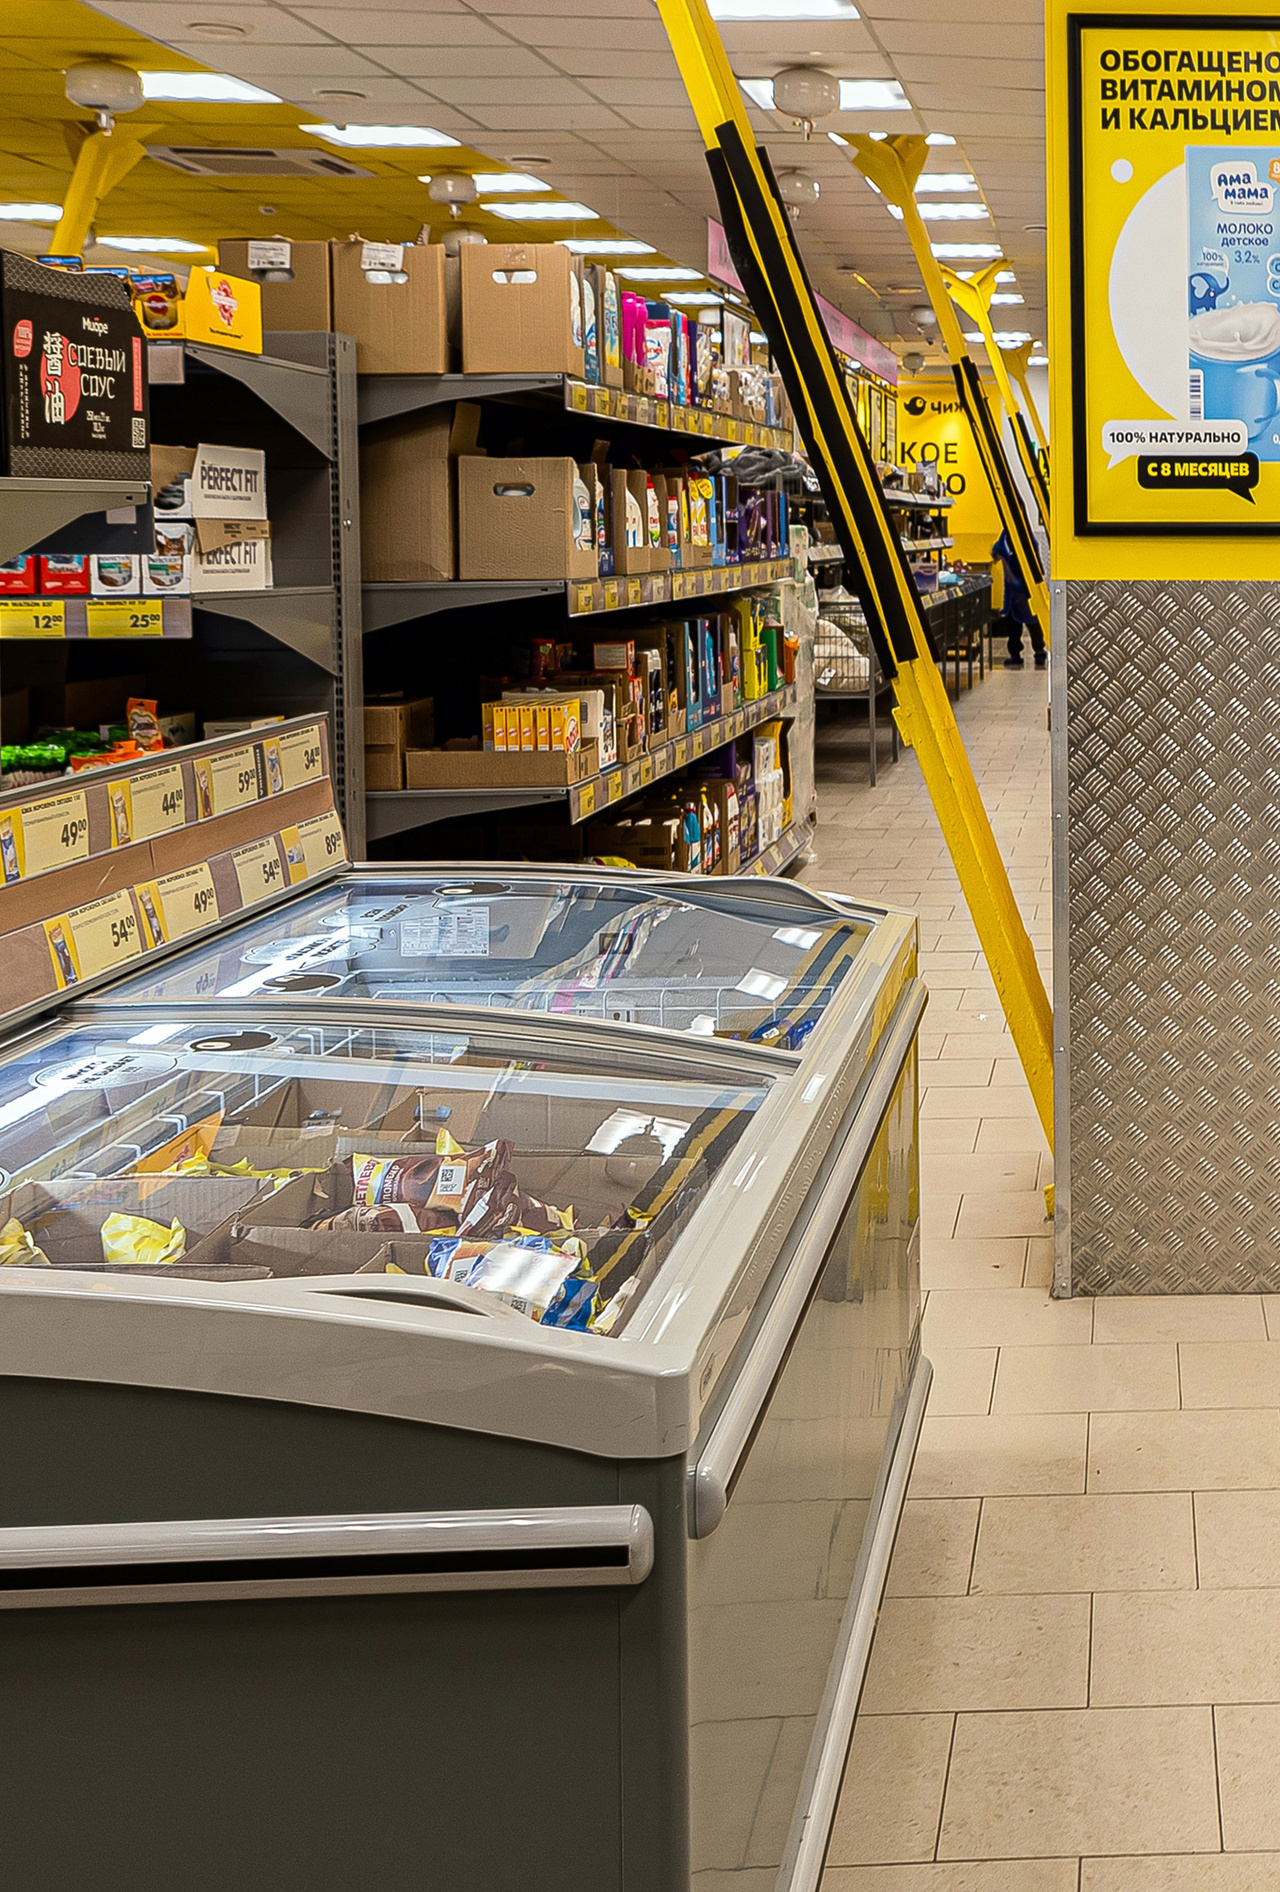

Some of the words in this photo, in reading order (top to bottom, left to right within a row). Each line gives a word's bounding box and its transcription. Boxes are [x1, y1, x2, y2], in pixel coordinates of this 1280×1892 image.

[1101, 108, 1120, 130] И
[1217, 223, 1274, 235] МОЛОКО
[1221, 237, 1269, 247] детское
[1202, 252, 1225, 261] 100%
[1234, 250, 1260, 264] 3,2%
[67, 343, 127, 373] СОЕВЫЙ
[81, 374, 116, 399] СОУС
[1109, 432, 1146, 443] 100%
[1149, 432, 1241, 444] НАТУРАЛЬНО
[1147, 463, 1158, 477] С
[1160, 463, 1171, 477] 8
[1174, 463, 1250, 479] МЕСЯЦЕВ
[200, 466, 243, 493] PERFECT
[245, 469, 259, 493] FIT
